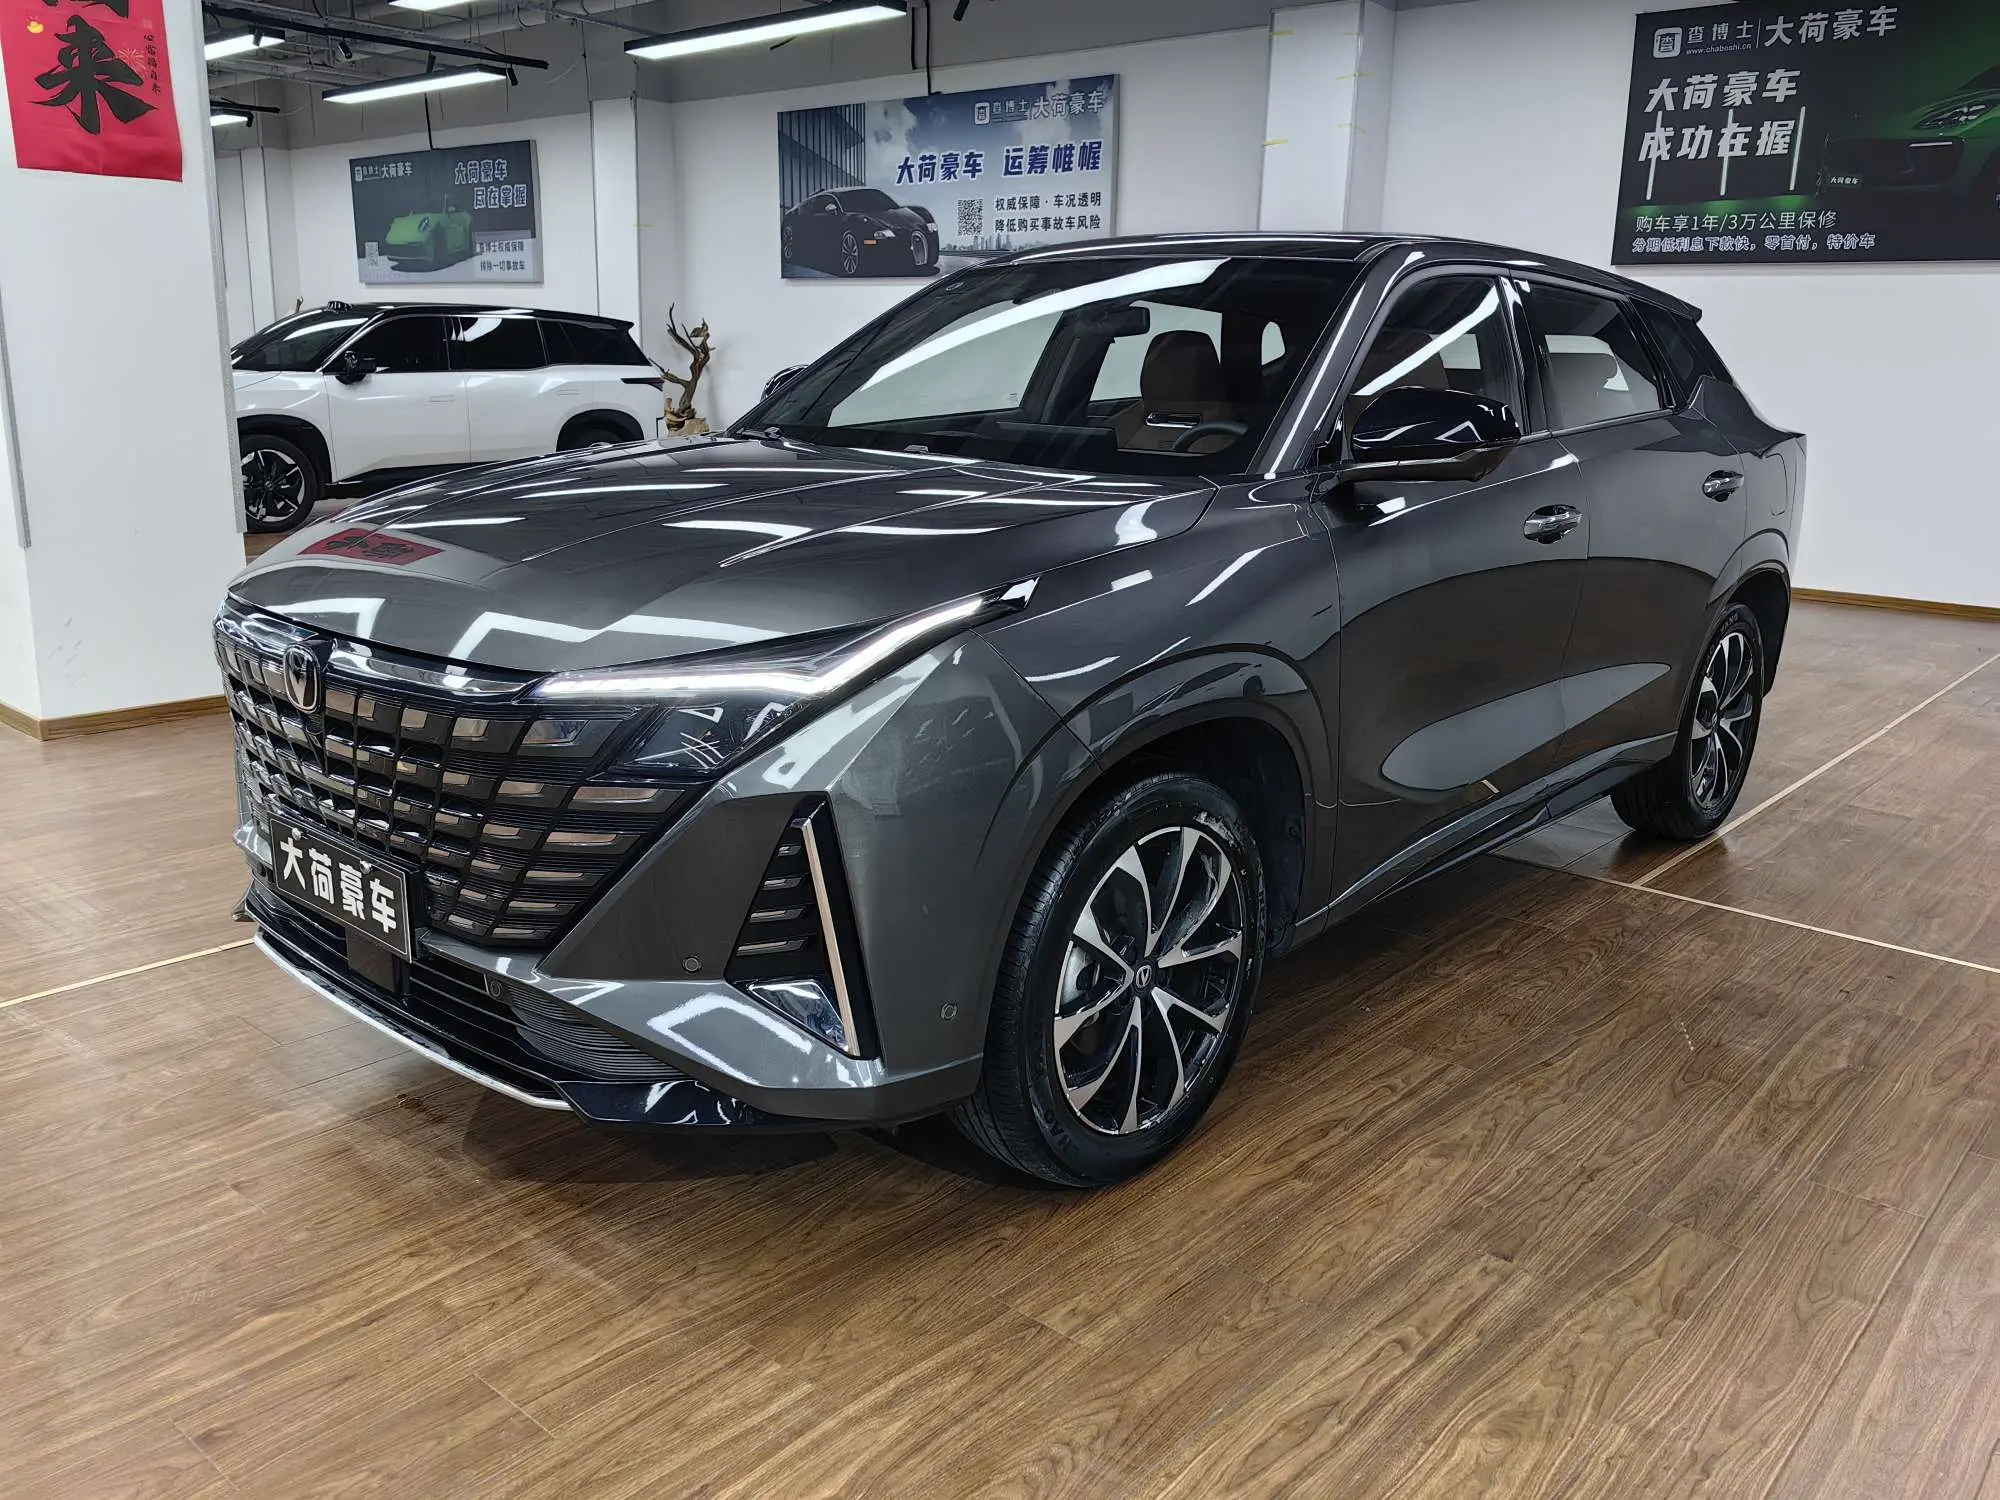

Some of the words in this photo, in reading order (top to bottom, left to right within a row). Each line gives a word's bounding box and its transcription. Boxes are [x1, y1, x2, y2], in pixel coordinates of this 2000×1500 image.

[1688, 20, 1754, 44] 查博士
[1764, 5, 1898, 48] 大荷豪车
[1033, 91, 1104, 119] 大荷豪车
[1644, 69, 1800, 113] 大荷豪车
[1637, 119, 1796, 162] 成功在握
[455, 159, 508, 185] 大荷豪车
[896, 151, 985, 185] 大荷豪车
[1003, 141, 1103, 177] 运筹帷幄
[474, 184, 527, 209] 尽在掌握
[995, 215, 1102, 233] 降低购买事故车风险
[1635, 210, 1838, 233] 购车享1年/3万公里保修
[279, 837, 397, 934] 大荷豪车
